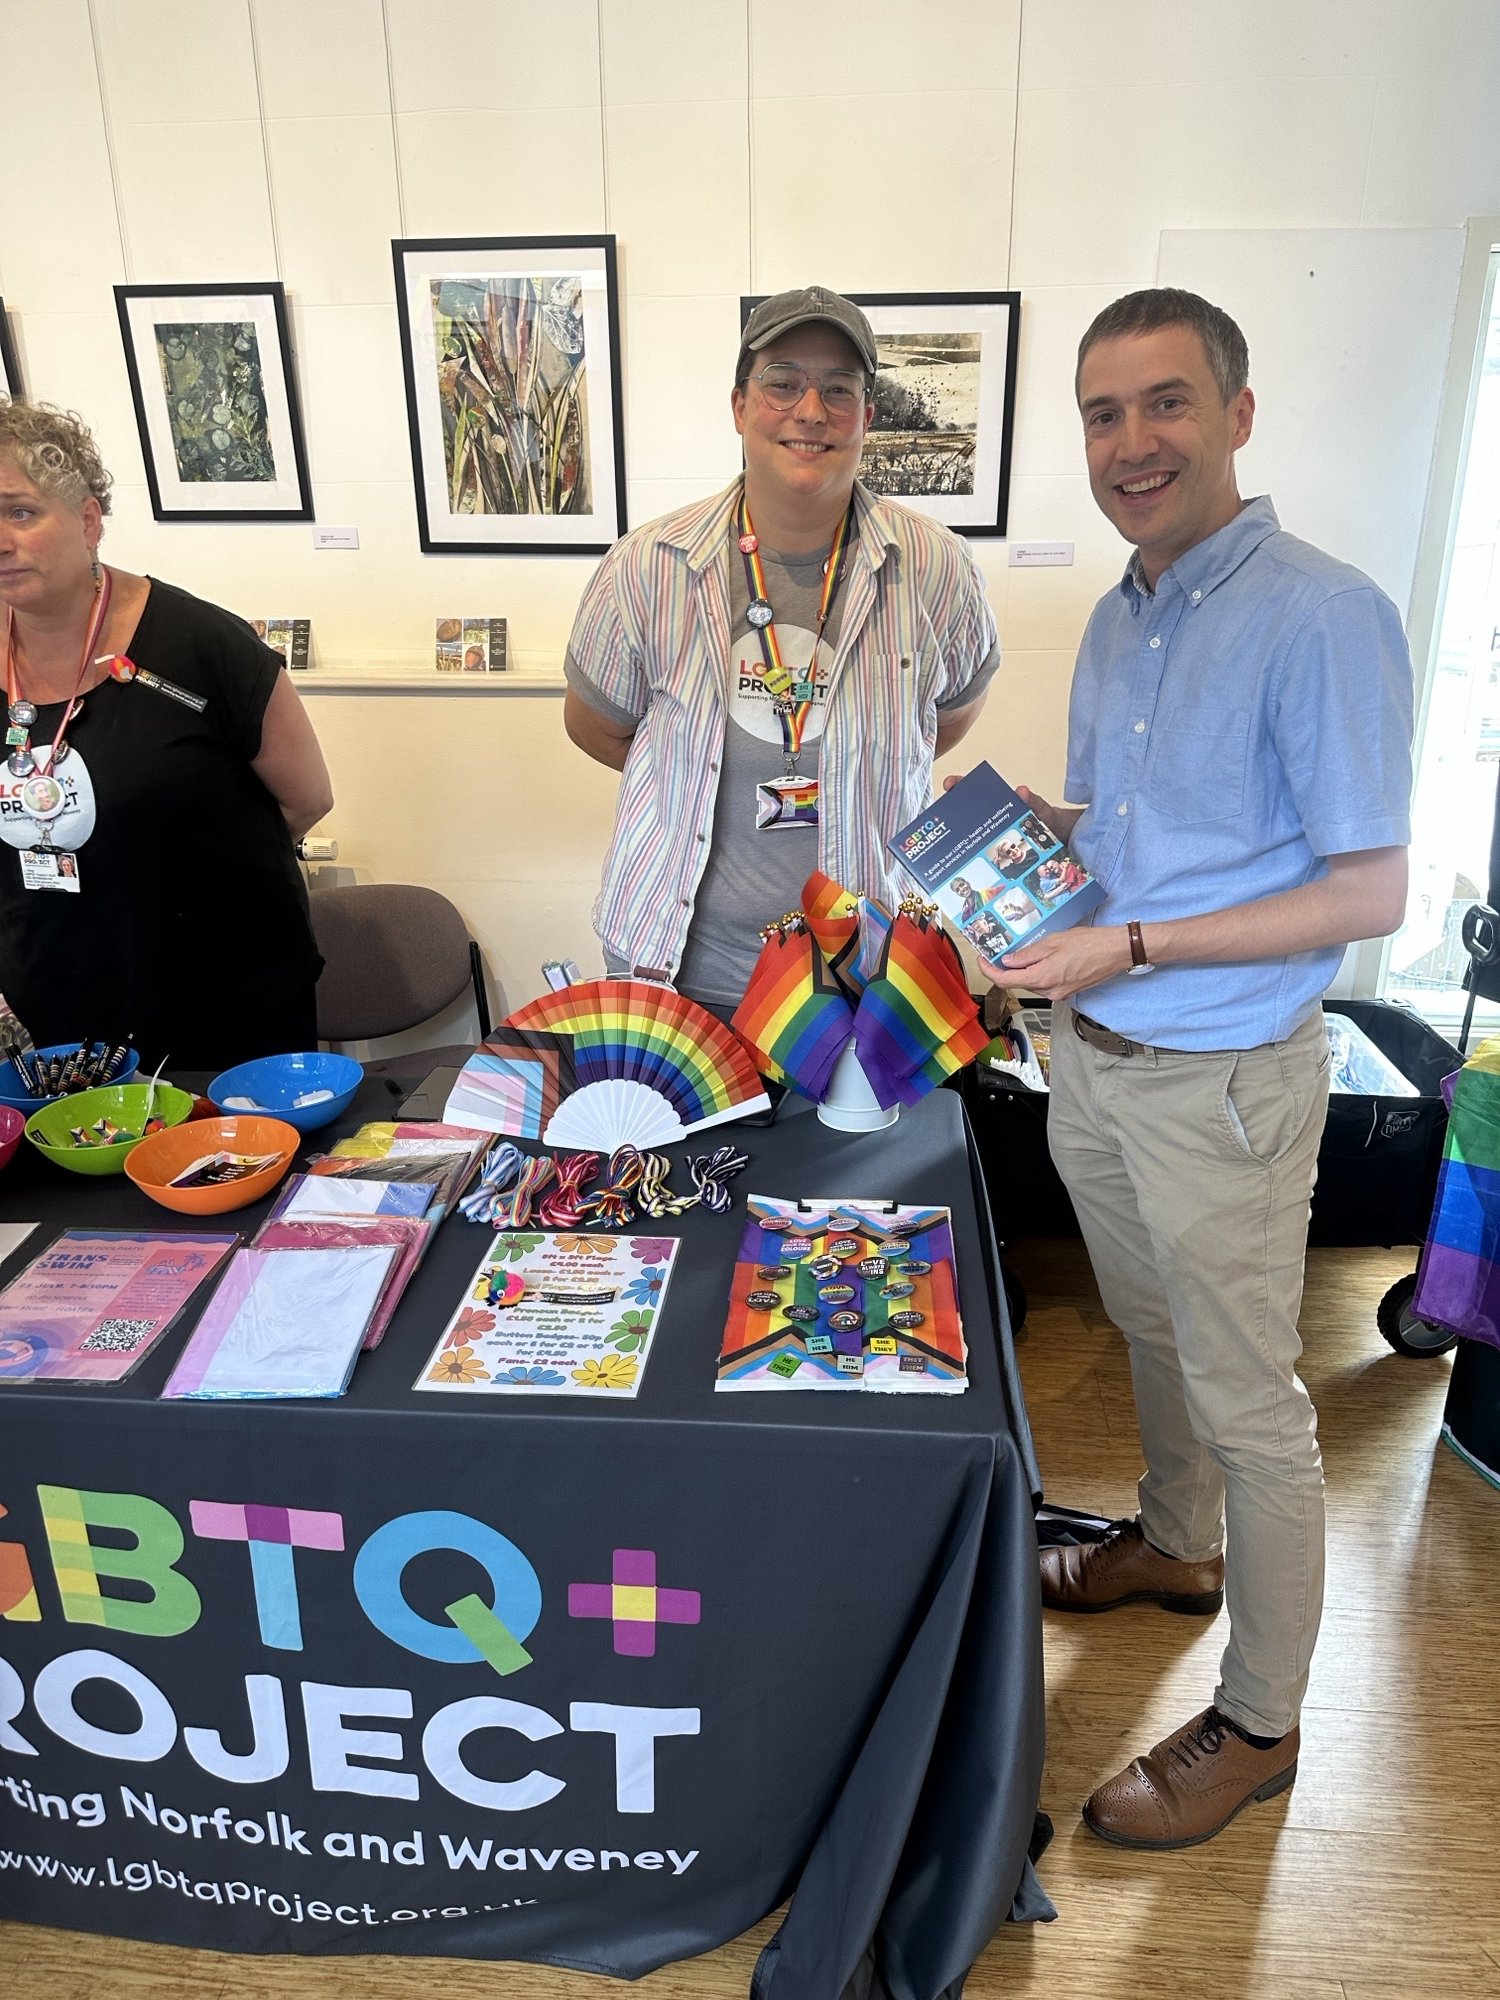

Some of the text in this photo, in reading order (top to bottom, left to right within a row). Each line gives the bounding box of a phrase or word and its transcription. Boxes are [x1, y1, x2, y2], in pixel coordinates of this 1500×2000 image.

[737, 693, 769, 701] Supporting
[899, 814, 940, 852] LGBTQ+
[905, 822, 947, 860] PROJECT
[928, 863, 940, 875] guide
[968, 826, 983, 839] health
[983, 818, 992, 828] and
[992, 801, 1014, 820] wellbeing
[928, 867, 945, 882] support
[945, 853, 962, 868] services
[965, 836, 982, 850] Norfolk
[982, 827, 991, 838] and
[990, 813, 1010, 830] Waveney
[46, 1253, 109, 1262] TRANS
[585, 1255, 618, 1263] Flags-
[35, 1261, 94, 1270] SWIM
[513, 1307, 559, 1315] Pronoun
[494, 1331, 534, 1339] Button
[535, 1332, 580, 1341] Badges-
[559, 1341, 575, 1349] £2
[782, 1357, 793, 1365] HE
[772, 1363, 791, 1374] THEY
[120, 1786, 312, 1855] Norfolk
[323, 1831, 425, 1867] and
[439, 1834, 700, 1875] Waveney
